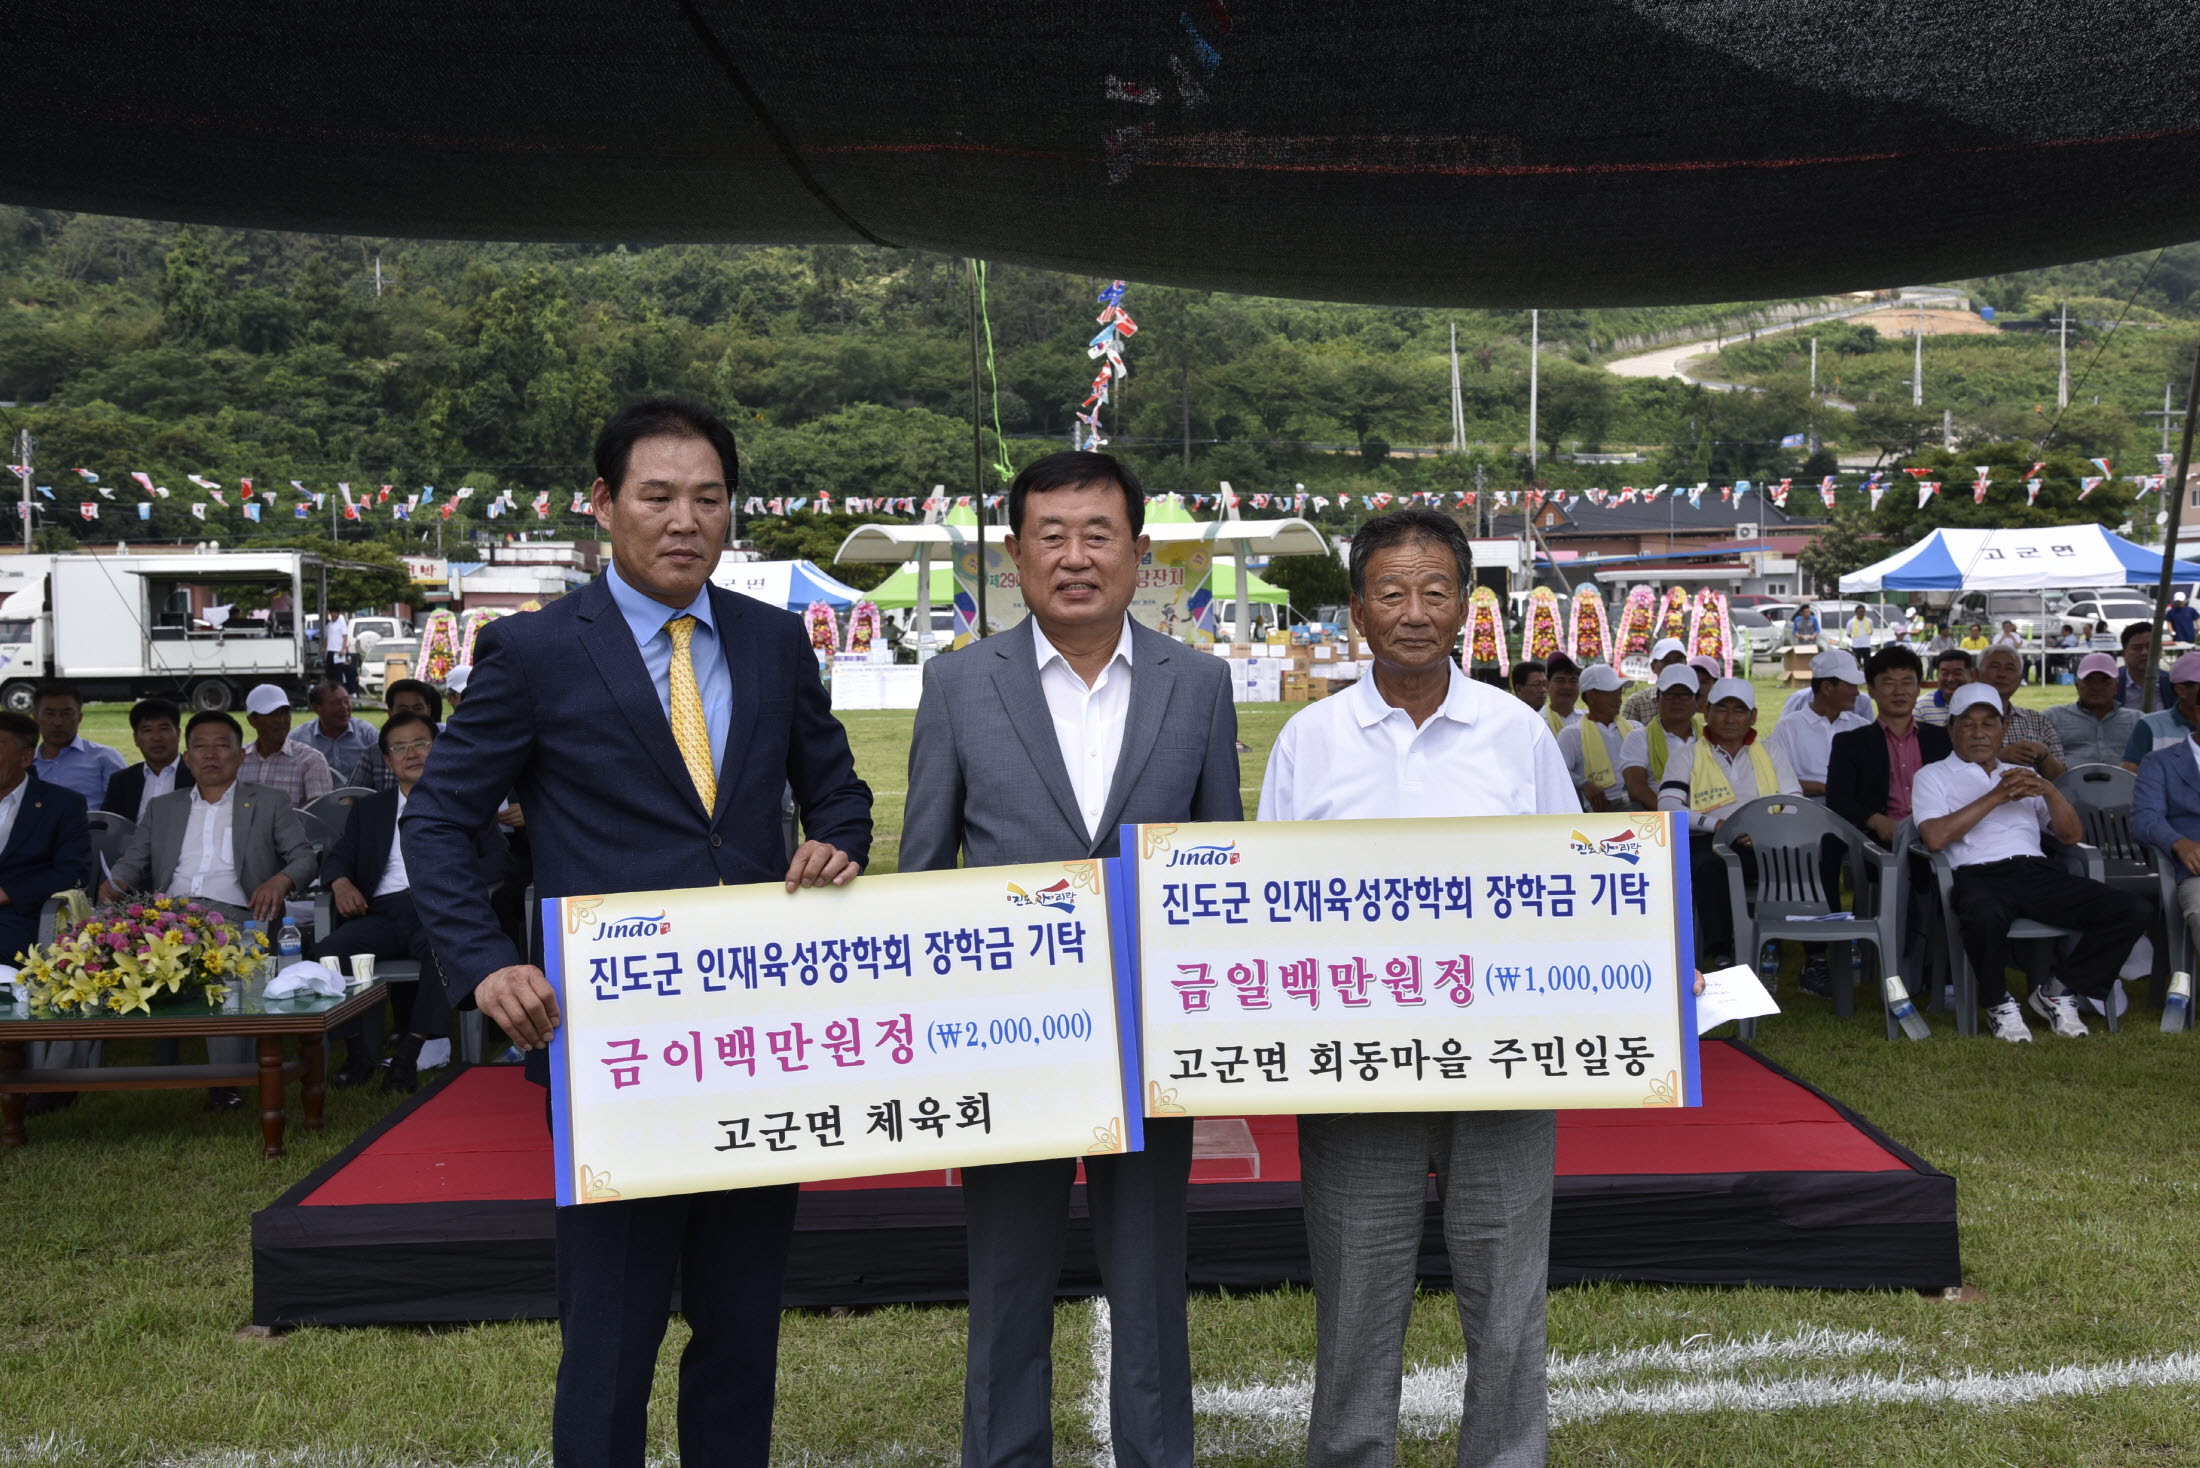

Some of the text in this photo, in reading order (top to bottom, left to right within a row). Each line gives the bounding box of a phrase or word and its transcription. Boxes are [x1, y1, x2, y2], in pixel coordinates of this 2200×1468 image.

[1980, 545, 2076, 560] 고군면
[1165, 849, 1228, 868] Jindo
[1162, 872, 1650, 926] 진도군 인재육성장학회 장학금 기탁
[592, 920, 658, 942] Jindo
[589, 920, 1086, 1001] 진도군 인재육성장학회 장학금 기탁
[1170, 954, 1652, 1013] 금일백만원정 (₩1,000,000)
[600, 1008, 1093, 1090] 금이백만원정 (₩2,000,000)
[1169, 1034, 1655, 1084] 고군면 회동마을 주민일동
[714, 1091, 992, 1152] 고군면 체육회
